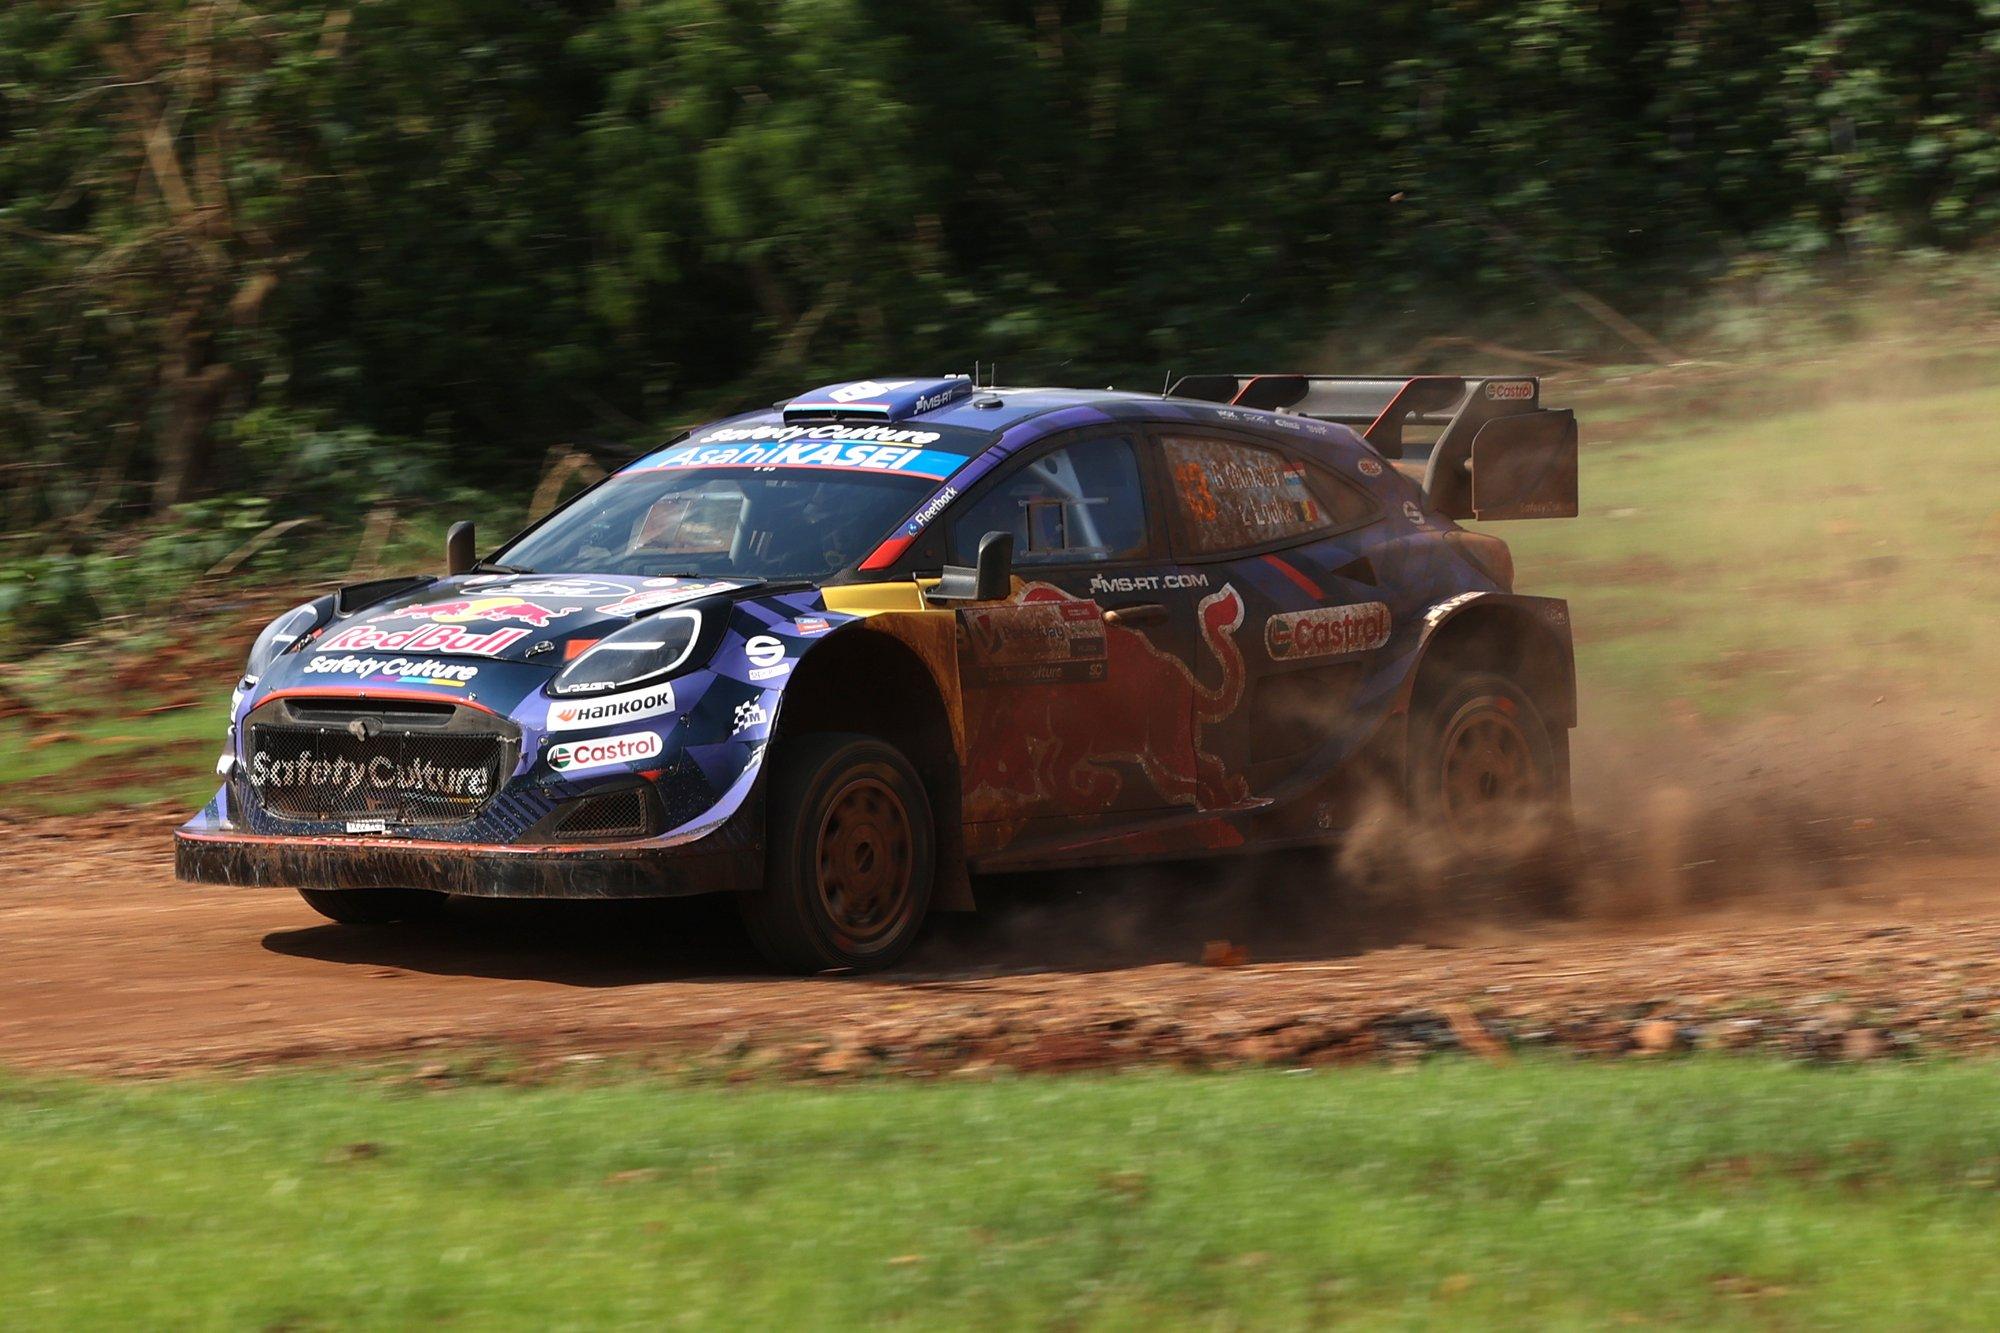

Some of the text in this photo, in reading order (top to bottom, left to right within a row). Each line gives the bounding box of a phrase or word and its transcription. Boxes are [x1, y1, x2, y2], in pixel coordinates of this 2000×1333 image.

[1497, 382, 1533, 398] Castrol
[701, 424, 941, 444] SafetyCulture
[317, 624, 532, 656] Red Bull
[1294, 610, 1385, 650] Castrol
[303, 655, 479, 680] SafetyCulture
[573, 736, 656, 764] Castrol
[250, 750, 489, 797] SafetyCulture
